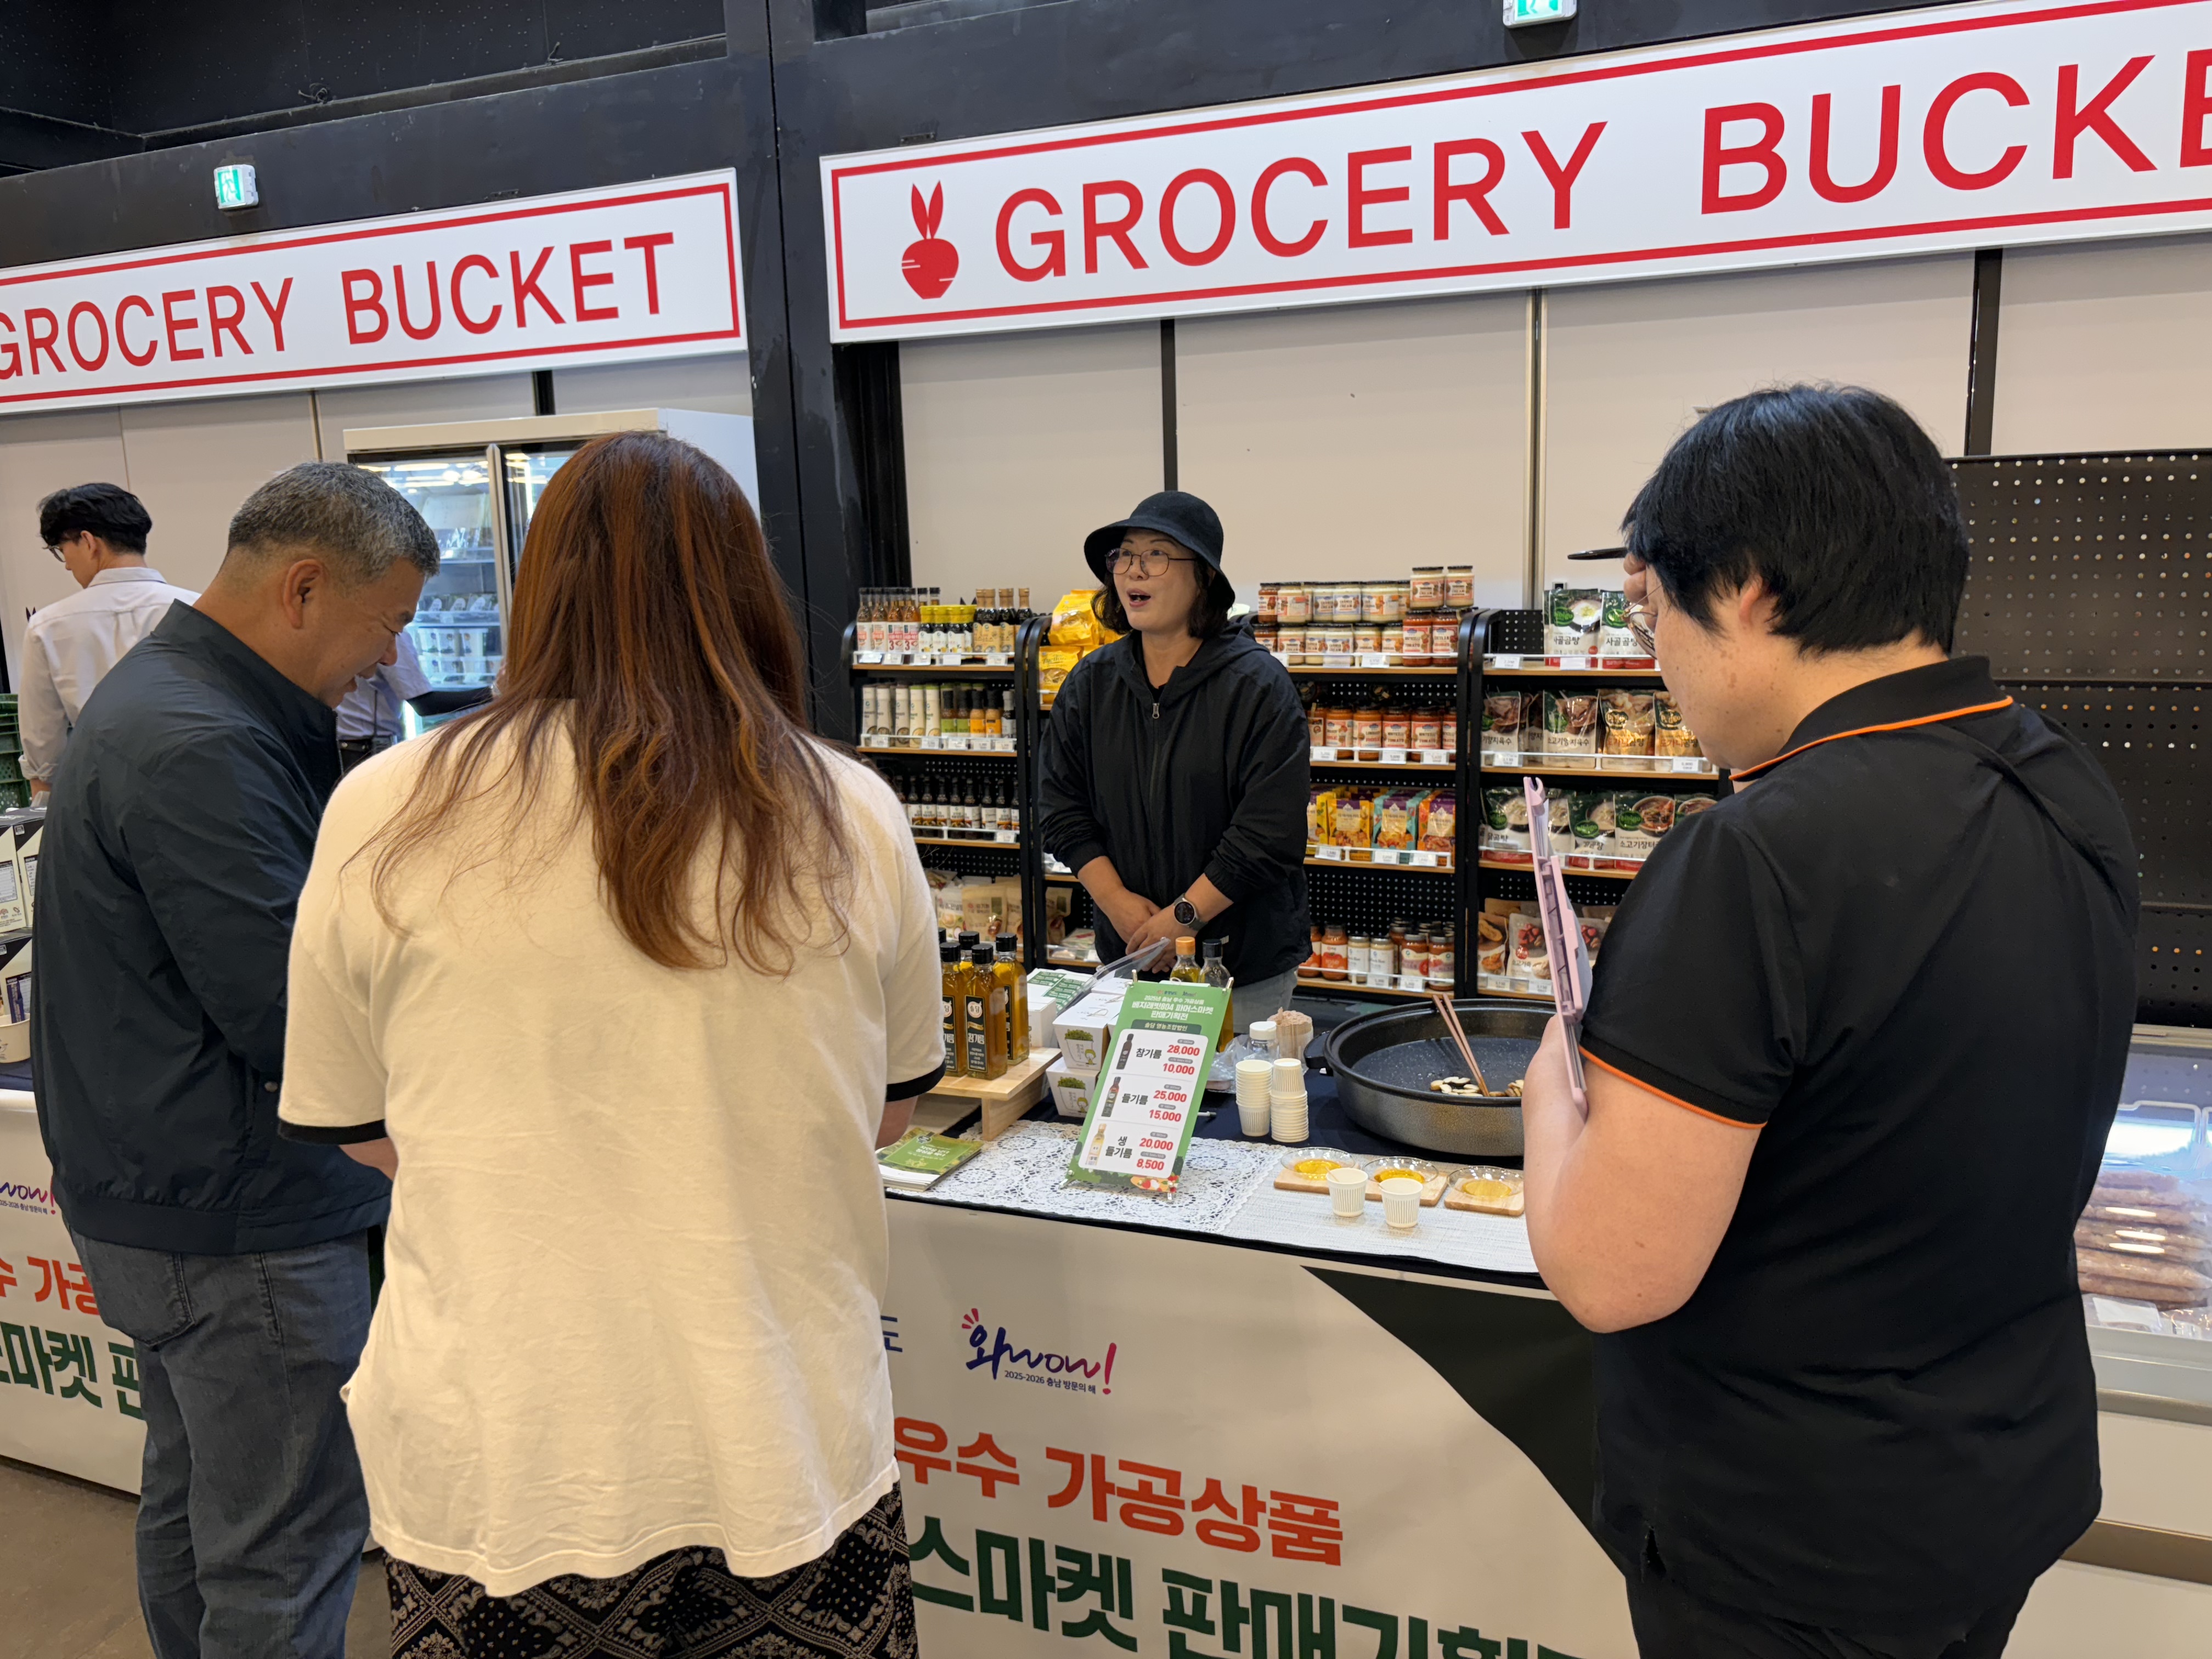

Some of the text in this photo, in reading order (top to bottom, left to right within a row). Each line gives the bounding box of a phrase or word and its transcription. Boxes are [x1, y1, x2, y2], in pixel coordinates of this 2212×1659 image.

[996, 121, 1608, 282] GROCERY
[0, 232, 675, 380] GROCERY BUCKET
[1136, 1048, 1163, 1059] 참기름
[1167, 1045, 1200, 1056] 28,000
[1163, 1063, 1195, 1075] 10,000
[1121, 1093, 1148, 1105] 들기름
[1153, 1090, 1187, 1103] 25,000
[1149, 1109, 1182, 1122] 15,000
[1118, 1136, 1127, 1146] 생
[1139, 1138, 1173, 1150] 20,000
[1105, 1146, 1132, 1159] 들기름
[1136, 1159, 1165, 1171] 8,500
[0, 1321, 103, 1408] 마켓
[1005, 1370, 1096, 1394] 2025-2026 충남 방문의 해
[893, 1417, 1344, 1566] 우수 가공상품
[909, 1515, 1601, 1659] 스마켓 판매기
